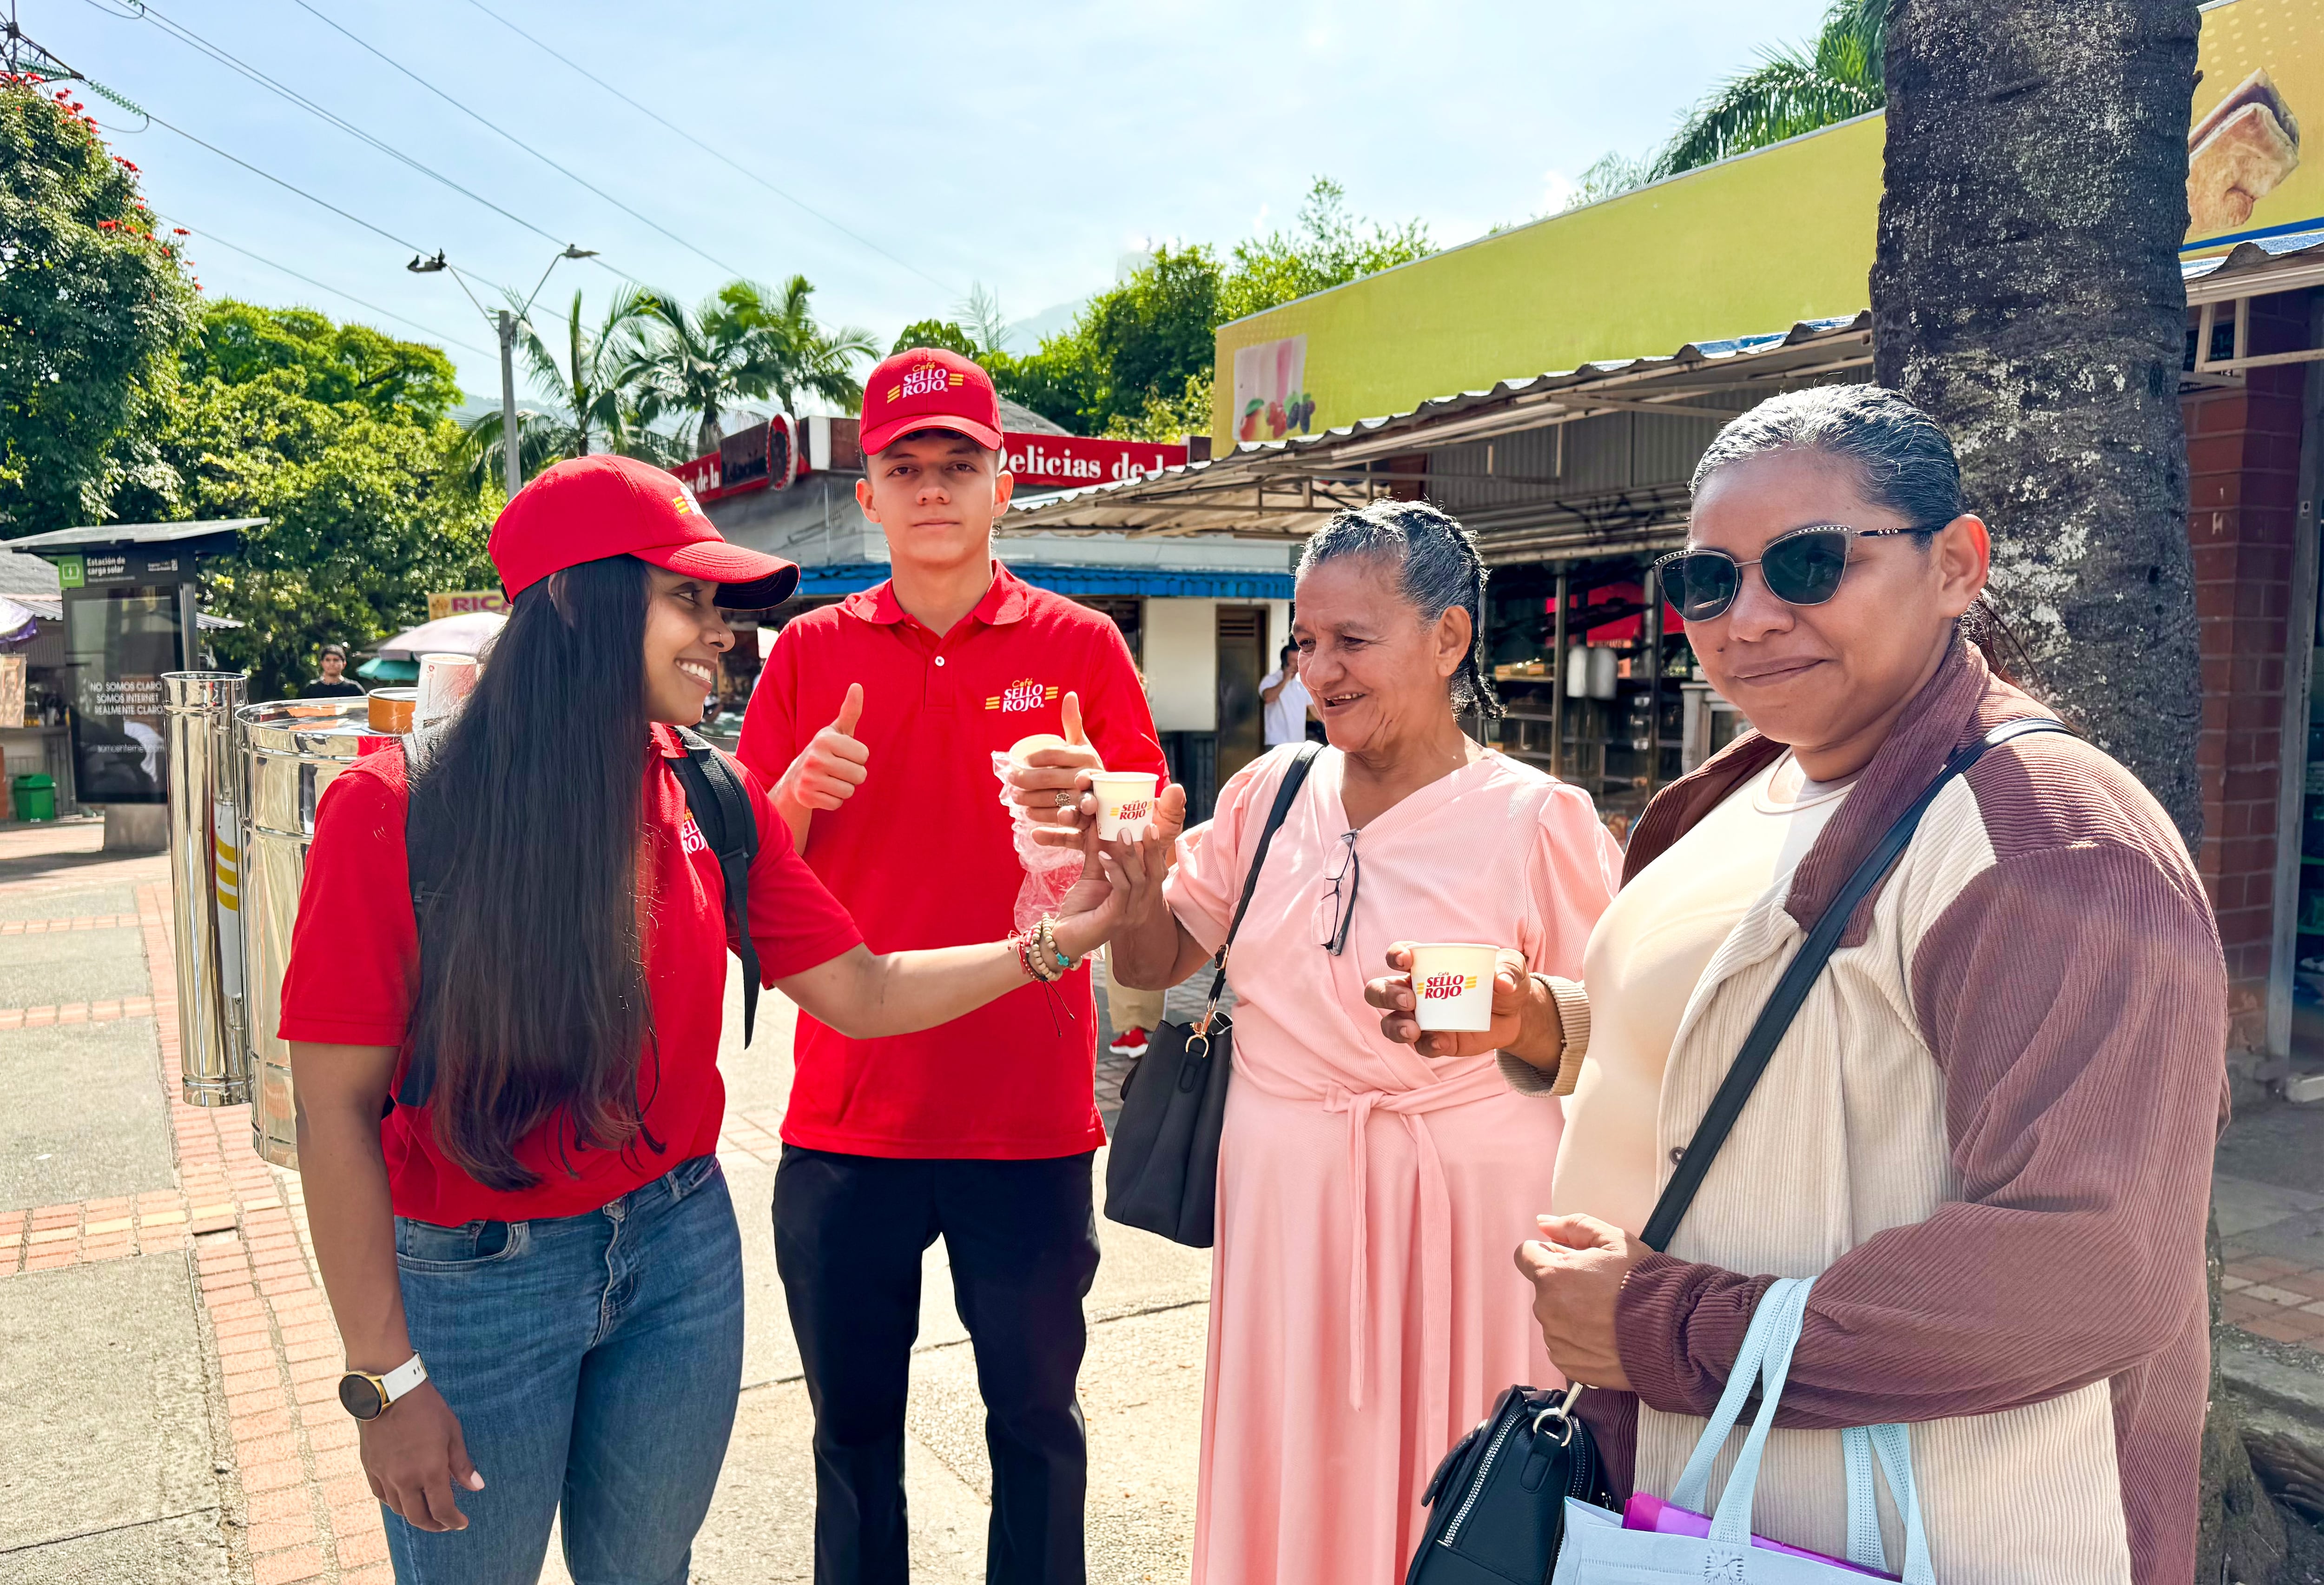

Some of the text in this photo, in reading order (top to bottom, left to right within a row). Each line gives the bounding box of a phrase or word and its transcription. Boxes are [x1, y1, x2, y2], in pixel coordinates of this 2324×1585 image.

[912, 362, 936, 372] Café
[903, 369, 947, 386] SELLO
[902, 379, 945, 398] ROJO
[1111, 452, 1145, 480] de
[696, 466, 708, 493] de
[710, 463, 720, 490] la
[87, 556, 126, 567] Estación de
[87, 565, 124, 577] carga solar
[90, 681, 162, 692] NO SOMOS CLARO
[1012, 678, 1033, 688] Café
[1004, 683, 1043, 700] SELLO
[97, 692, 158, 704] SOMOS INTERNET
[1003, 696, 1042, 712] ROJO
[95, 705, 135, 715] REALMENTE
[1122, 801, 1147, 811] SELLO
[1119, 809, 1146, 820] ROJO
[1426, 975, 1464, 987] SELLO
[1425, 986, 1462, 999] ROJO
